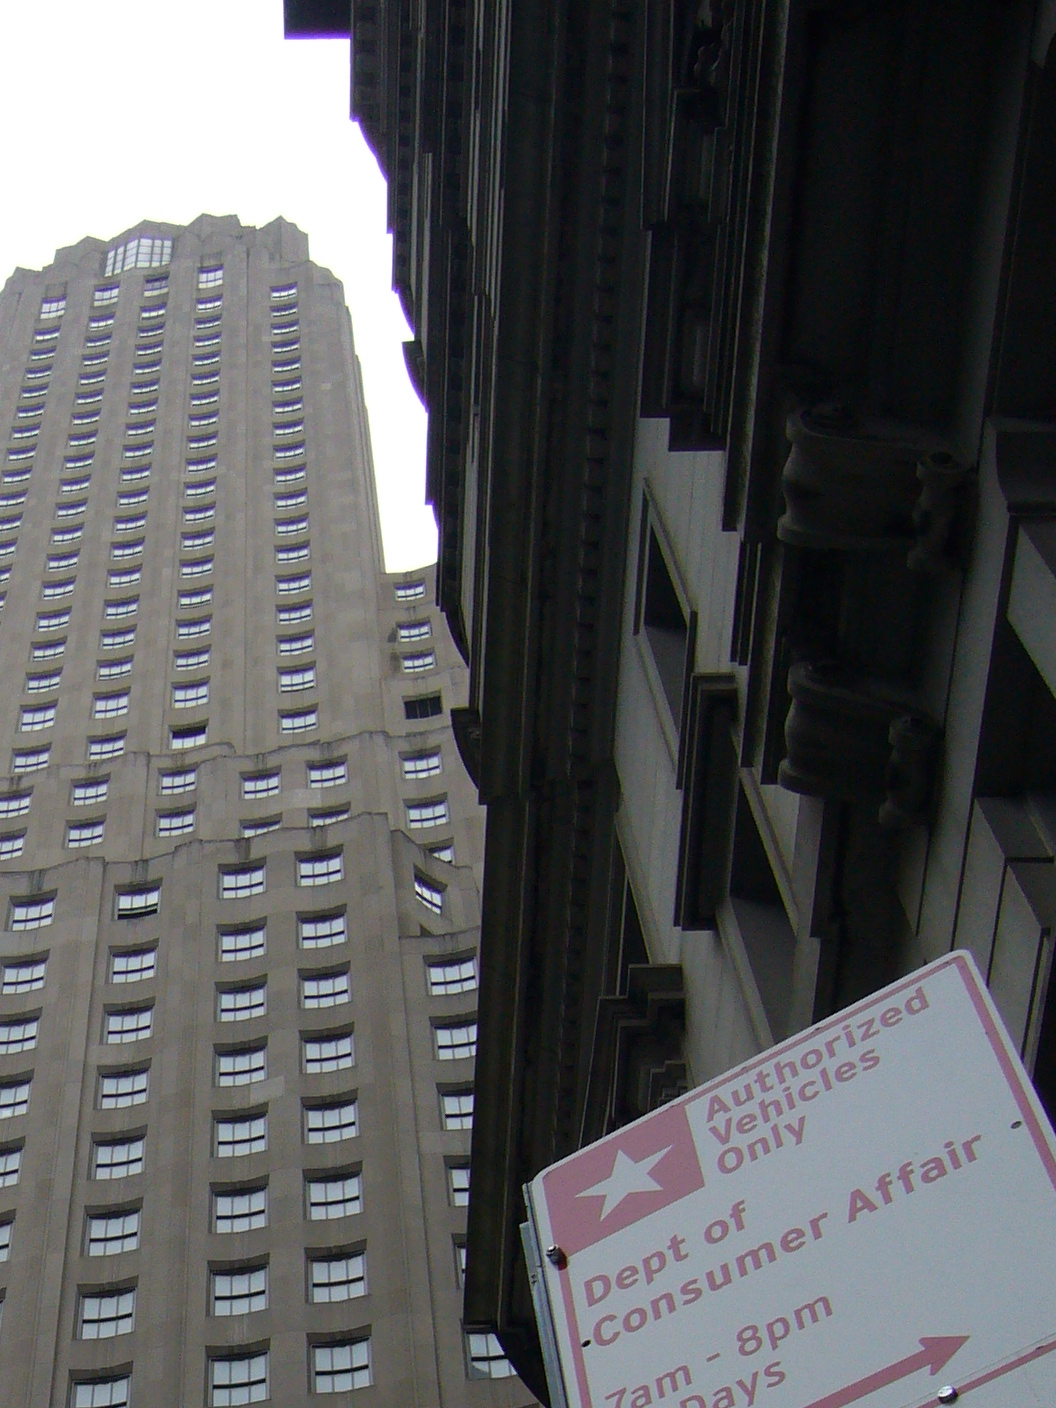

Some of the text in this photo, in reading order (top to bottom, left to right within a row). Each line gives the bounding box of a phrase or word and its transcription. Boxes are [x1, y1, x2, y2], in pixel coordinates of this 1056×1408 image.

[705, 986, 931, 1124] Authorized
[709, 1048, 882, 1145] Vehicles
[717, 1115, 808, 1176] Only
[584, 1200, 747, 1307] Dept of
[593, 1133, 984, 1347] Consumer Affair
[706, 1351, 721, 1363] -
[736, 1295, 834, 1356] 8pm
